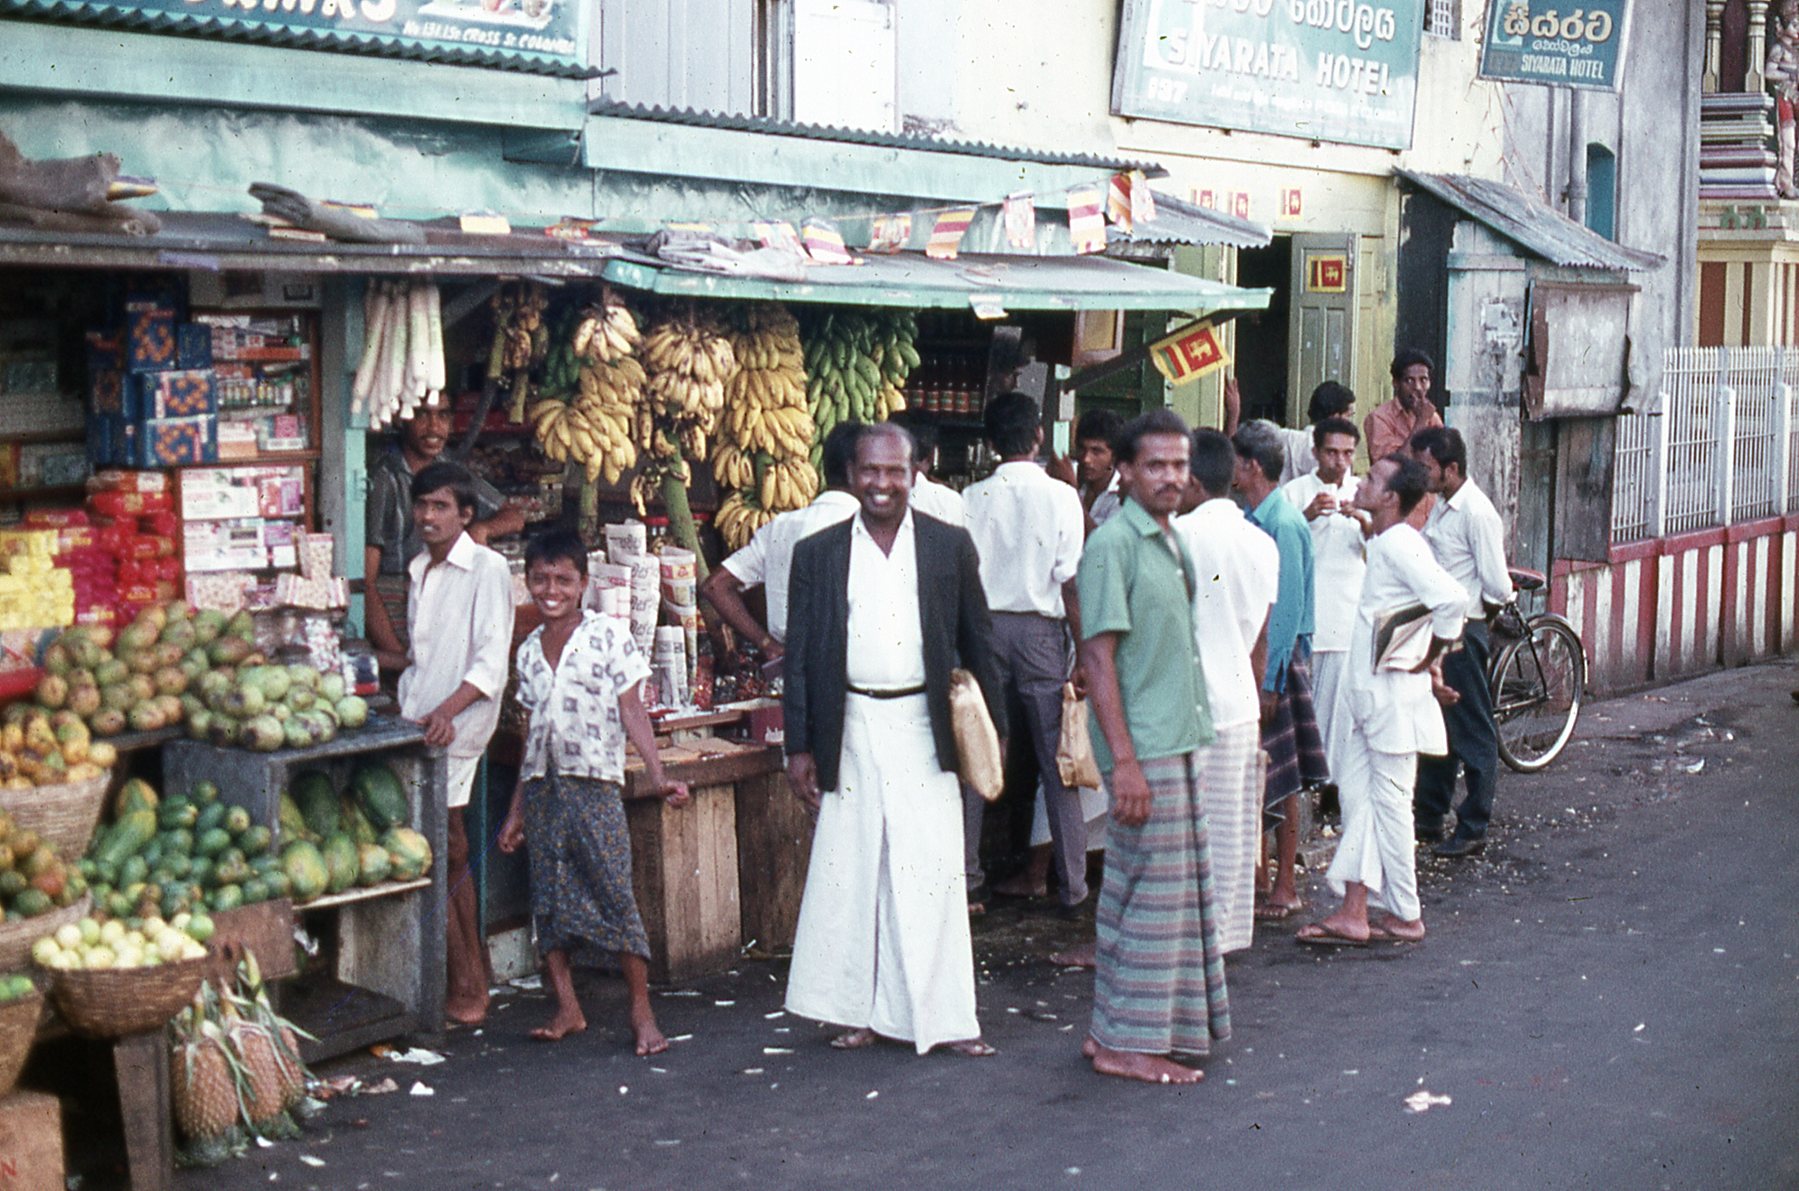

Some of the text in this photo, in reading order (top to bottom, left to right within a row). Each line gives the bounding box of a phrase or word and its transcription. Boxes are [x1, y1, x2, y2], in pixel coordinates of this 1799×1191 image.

[462, 27, 501, 46] CROSS
[1168, 27, 1391, 96] SIYARATA HOTEL
[1521, 54, 1567, 76] SIYARATA
[1569, 58, 1604, 79] HOTEL
